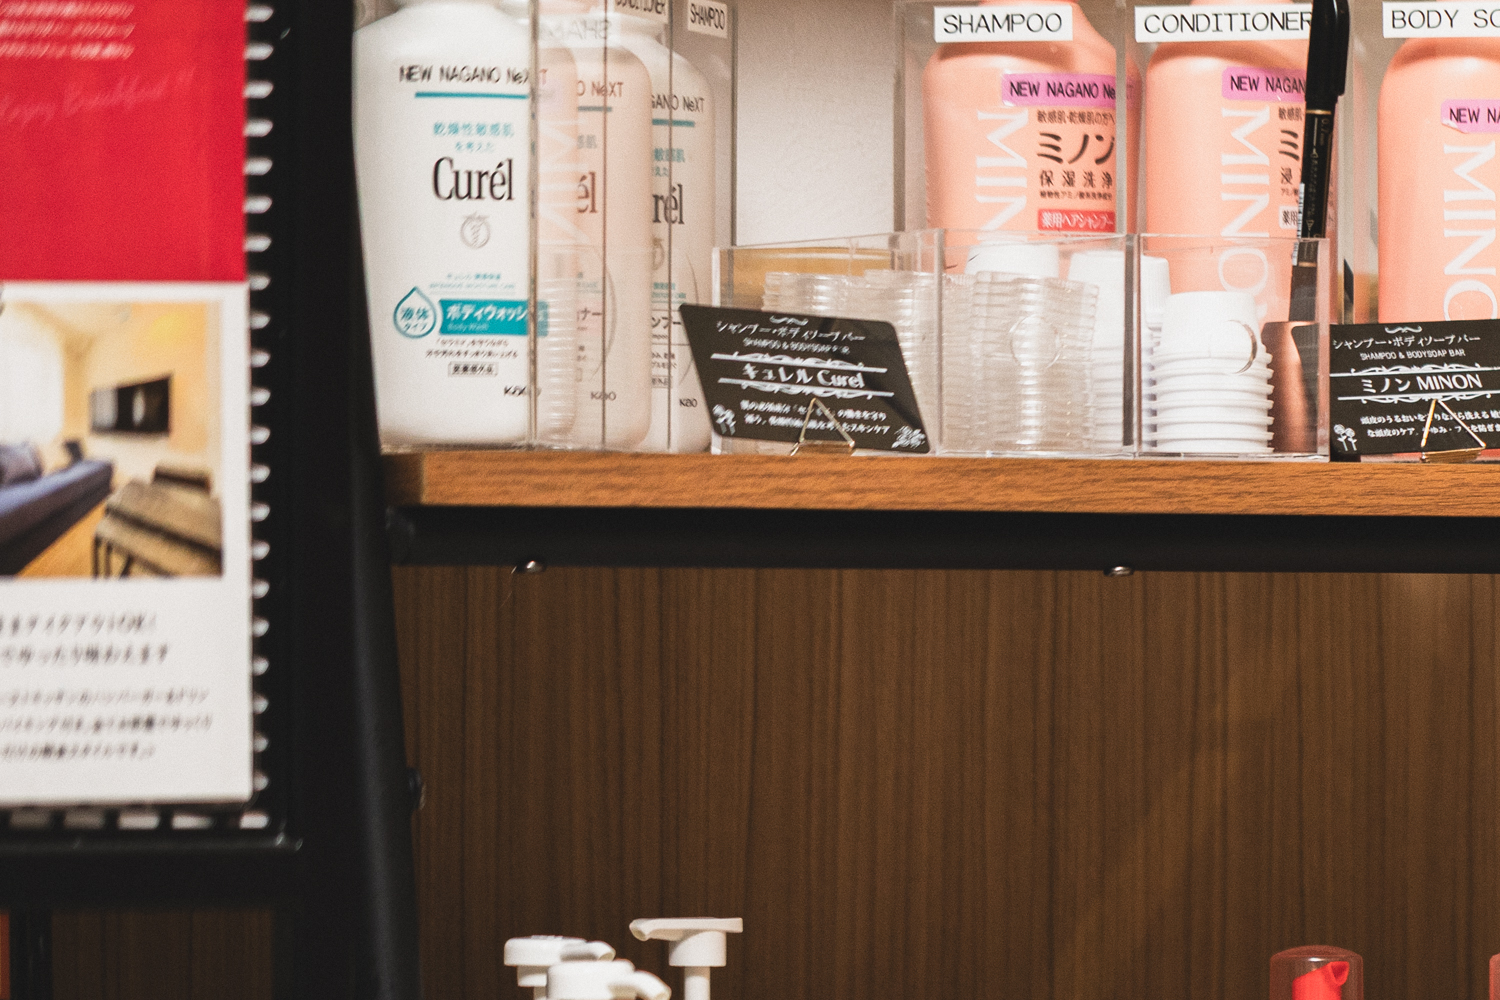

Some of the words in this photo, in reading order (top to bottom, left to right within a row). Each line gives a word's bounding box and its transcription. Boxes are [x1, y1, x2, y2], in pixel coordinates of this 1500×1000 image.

[942, 13, 1063, 34] SHAMPOO
[1144, 12, 1311, 34] CONDITIONER
[1391, 9, 1458, 29] BODY
[399, 65, 433, 82] NEW
[439, 65, 502, 83] NAGANO
[1010, 81, 1041, 97] NEW
[1046, 82, 1099, 99] NAGANO
[1230, 76, 1260, 92] NEW
[1266, 77, 1306, 94] NAGAN
[652, 94, 680, 111] GANO
[1450, 108, 1480, 125] NEW
[1036, 131, 1116, 165] ミノン
[431, 156, 515, 201] Curél
[1360, 351, 1397, 361] SHAMPOO
[1449, 348, 1466, 358] BAR
[742, 363, 814, 385] キュレル
[817, 369, 866, 389] Curel
[1361, 376, 1411, 394] ミノン
[1416, 373, 1484, 391] MINON
